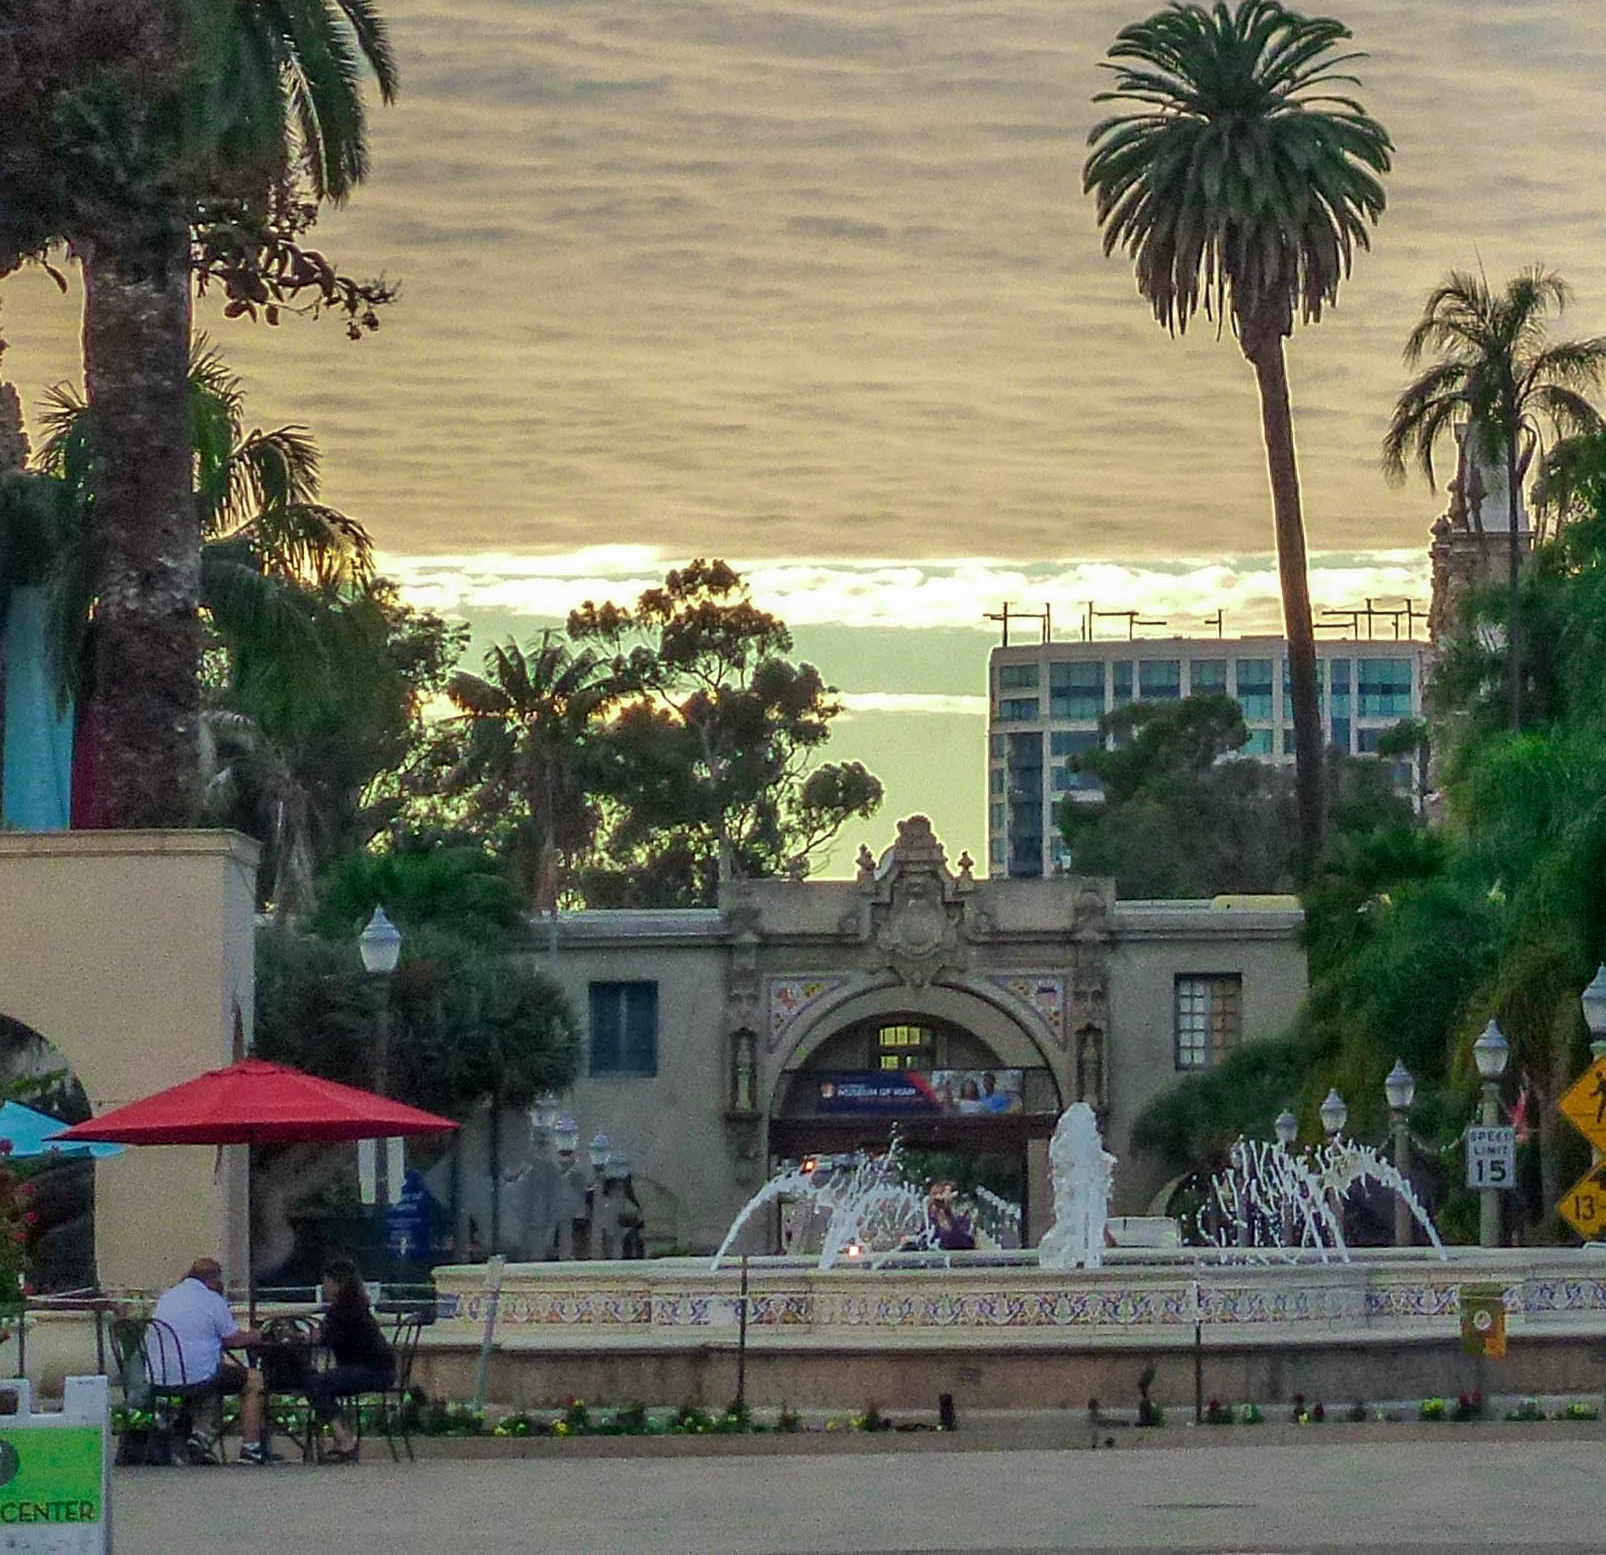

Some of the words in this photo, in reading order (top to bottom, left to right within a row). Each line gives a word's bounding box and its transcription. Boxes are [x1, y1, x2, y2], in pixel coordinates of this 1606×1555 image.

[1471, 1131, 1511, 1142] SPEED
[1474, 1146, 1508, 1155] LIMIT
[1477, 1159, 1507, 1182] 15
[0, 1500, 95, 1524] CENTER
